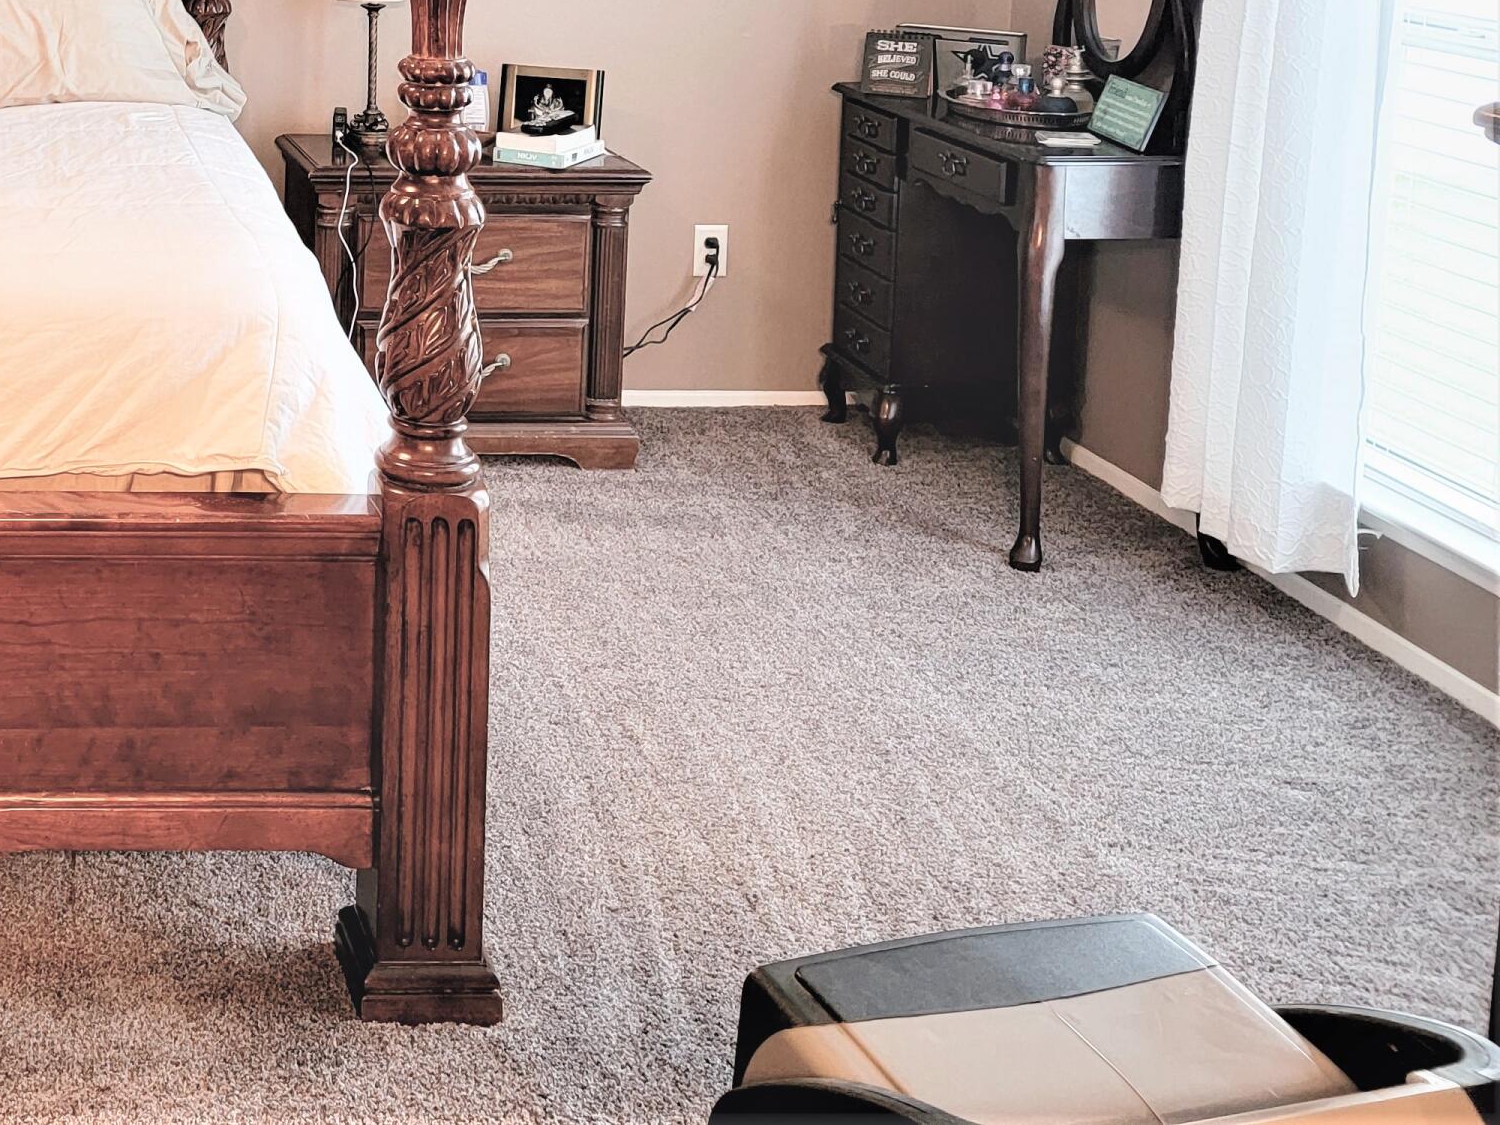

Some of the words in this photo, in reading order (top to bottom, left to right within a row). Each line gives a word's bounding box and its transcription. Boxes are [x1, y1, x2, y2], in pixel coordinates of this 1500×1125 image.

[877, 40, 917, 52] SHE
[877, 54, 916, 64] BELIEVED
[871, 69, 888, 78] SHE
[889, 70, 915, 81] COULD
